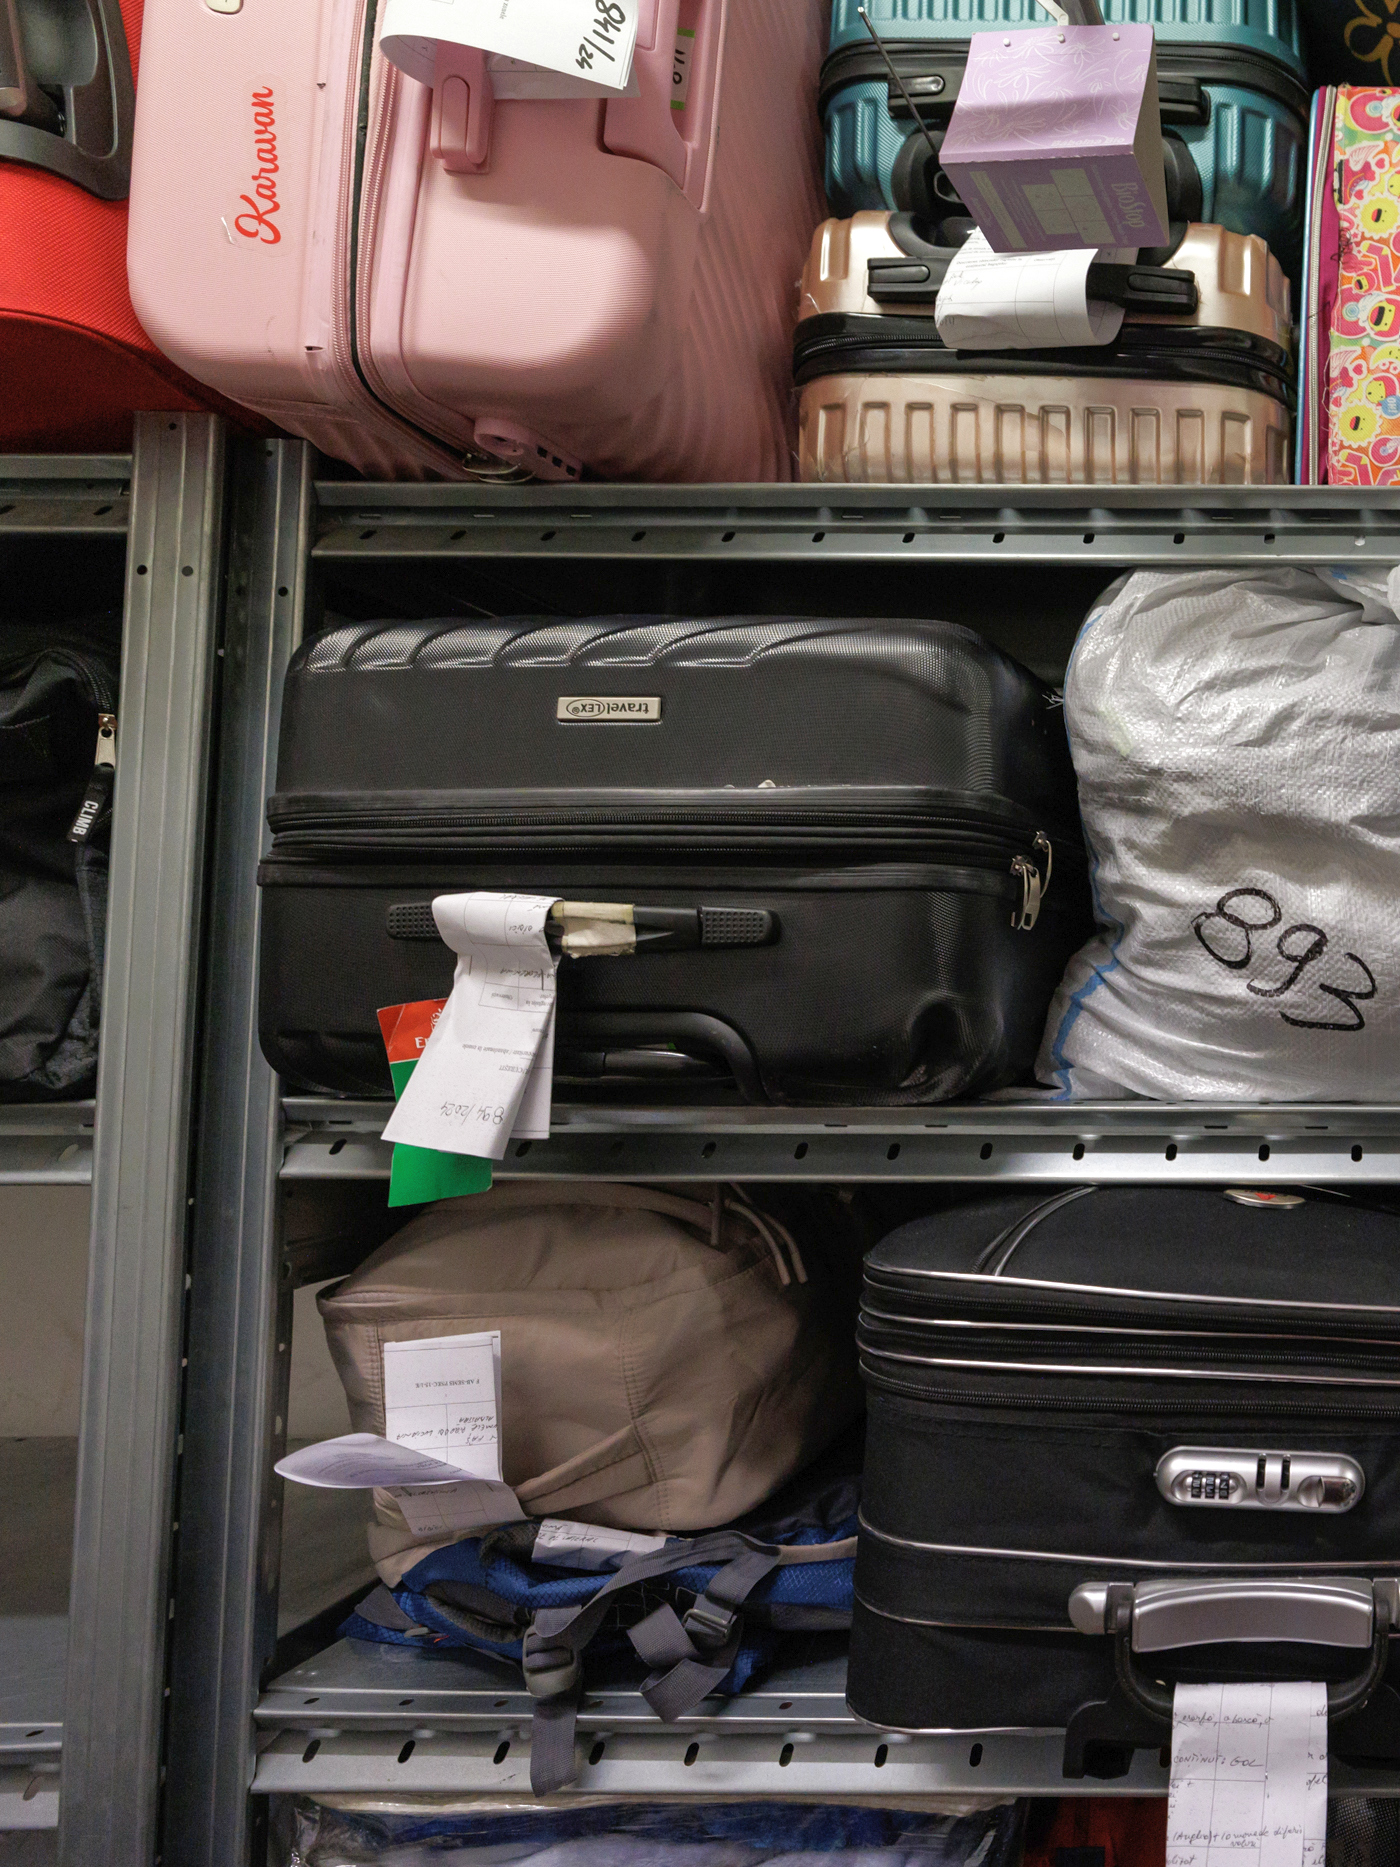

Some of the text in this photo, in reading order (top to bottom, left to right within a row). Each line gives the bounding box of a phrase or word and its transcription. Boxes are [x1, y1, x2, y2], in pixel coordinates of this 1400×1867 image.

[235, 85, 281, 244] Karavan
[1112, 182, 1145, 229] BioStop
[73, 800, 98, 835] CLIMB
[1190, 887, 1377, 1031] 893
[1230, 1756, 1264, 1767] GOL
